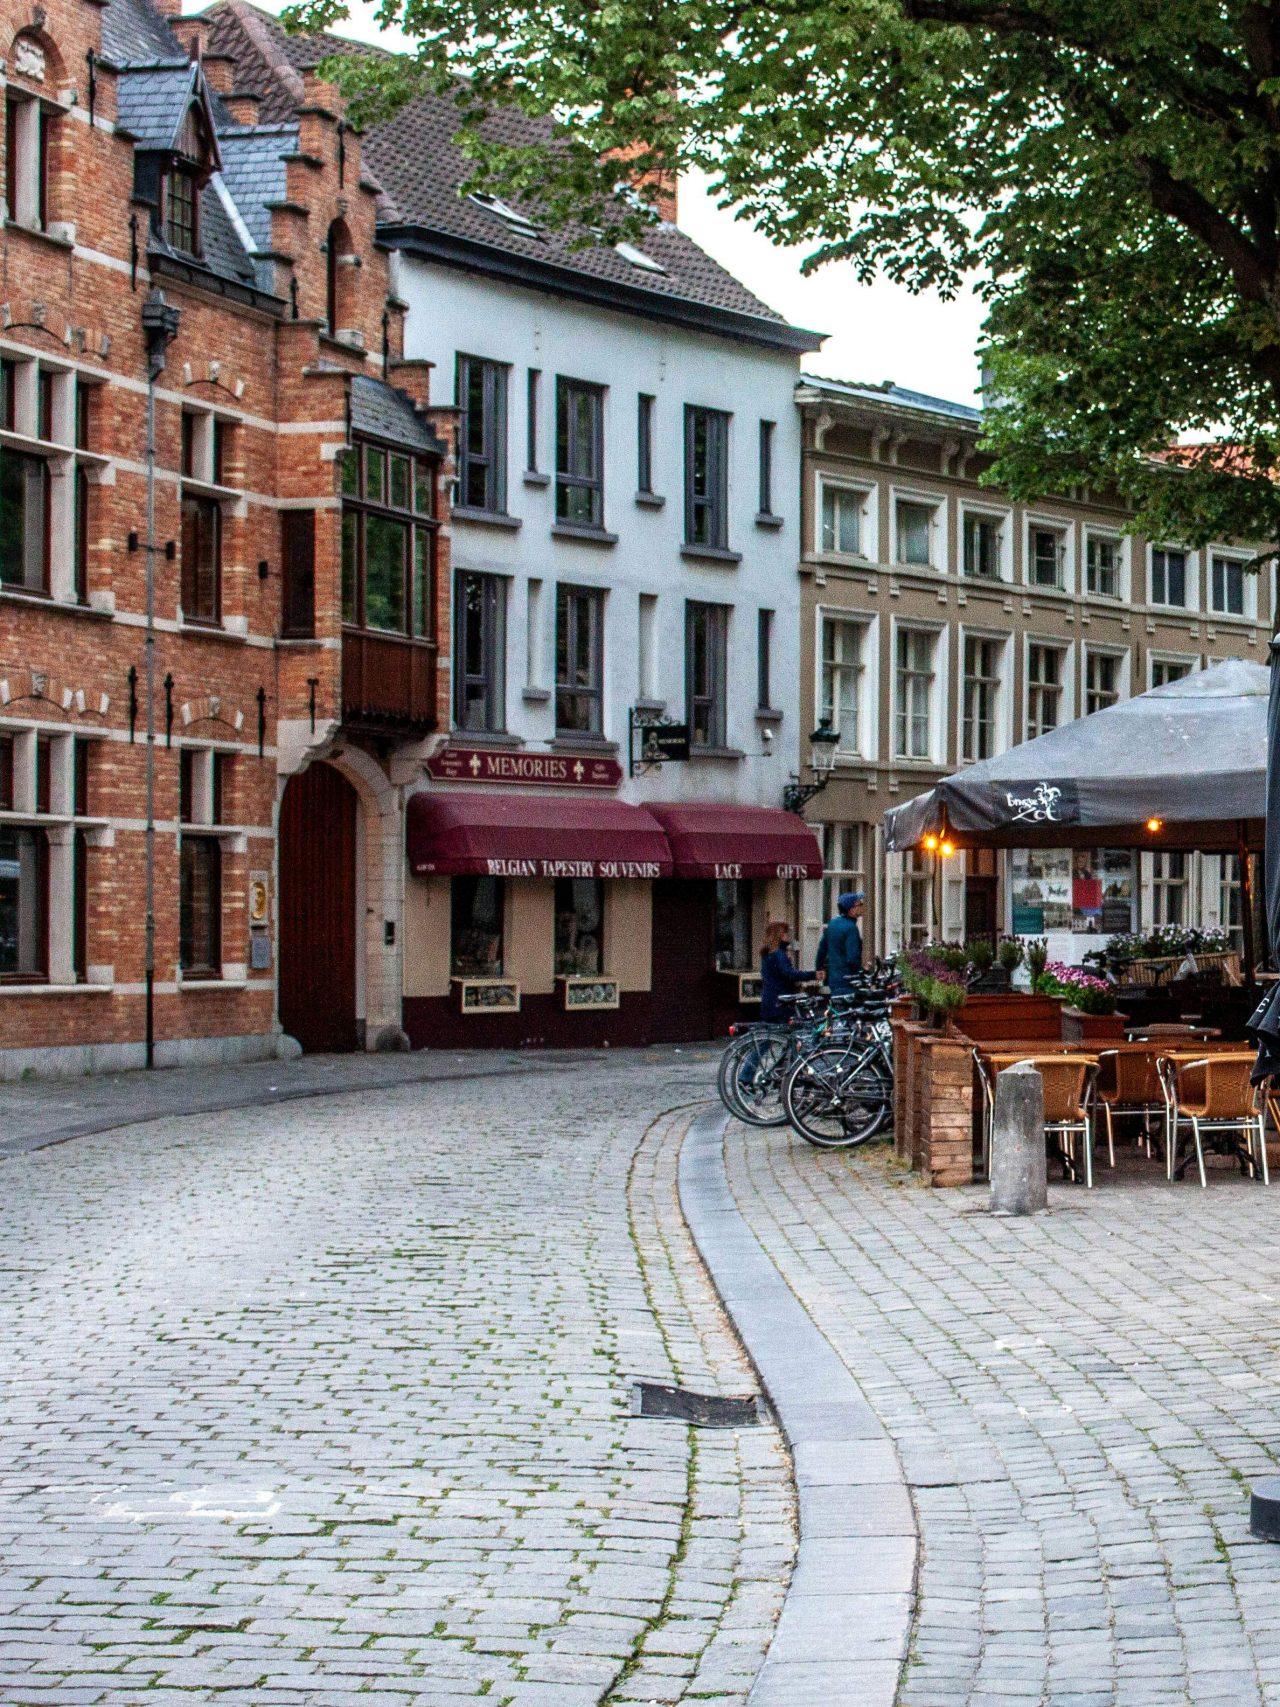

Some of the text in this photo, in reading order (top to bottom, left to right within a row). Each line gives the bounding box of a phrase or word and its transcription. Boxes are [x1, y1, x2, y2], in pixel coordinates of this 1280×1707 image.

[487, 755, 567, 779] MEMORIES
[487, 859, 660, 878] BELGIAN TAPESTRY SOUVENIRS
[714, 863, 808, 880] LACE GIFTS
